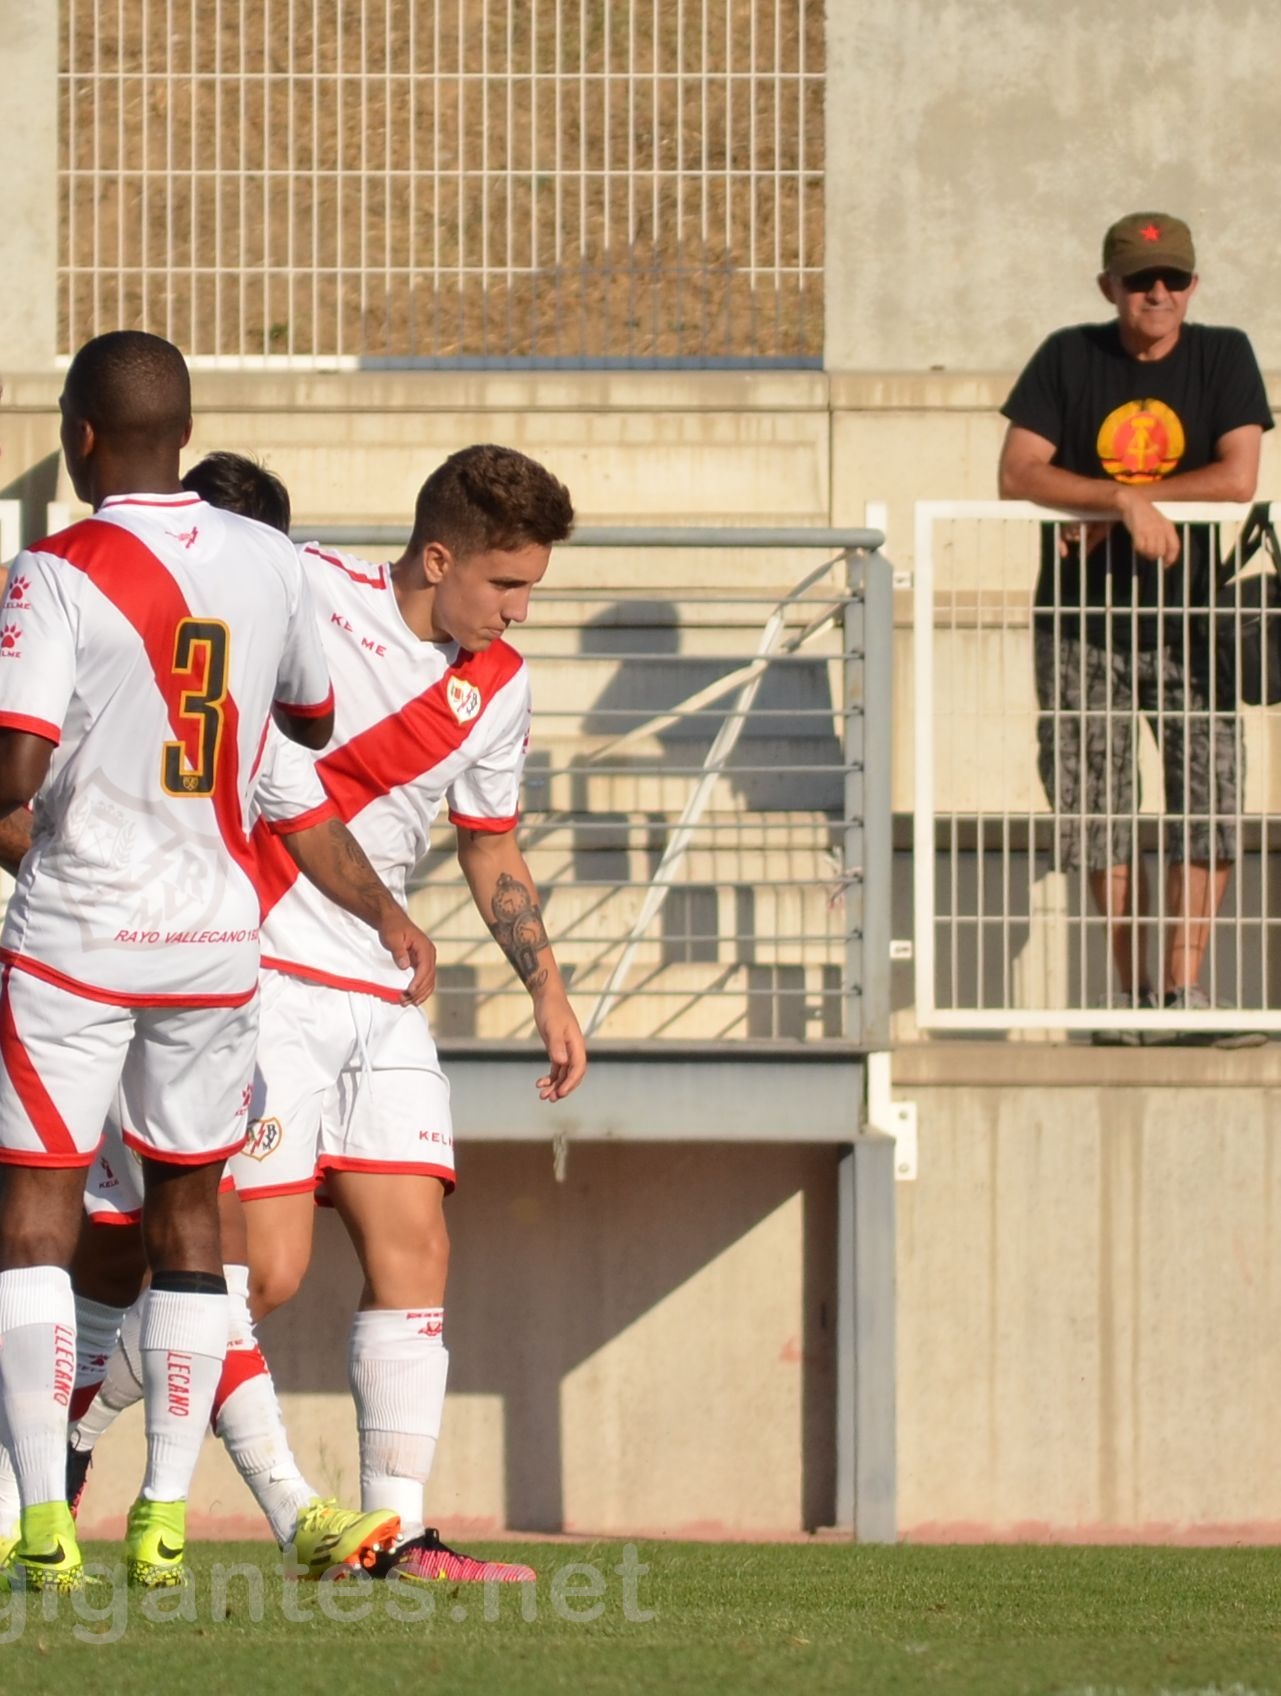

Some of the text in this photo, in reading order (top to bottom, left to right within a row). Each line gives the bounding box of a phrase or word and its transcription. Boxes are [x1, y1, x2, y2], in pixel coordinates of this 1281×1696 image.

[330, 612, 387, 657] KEME
[160, 616, 232, 798] 3
[114, 929, 160, 944] RAYO
[165, 929, 247, 944] VALLECANO
